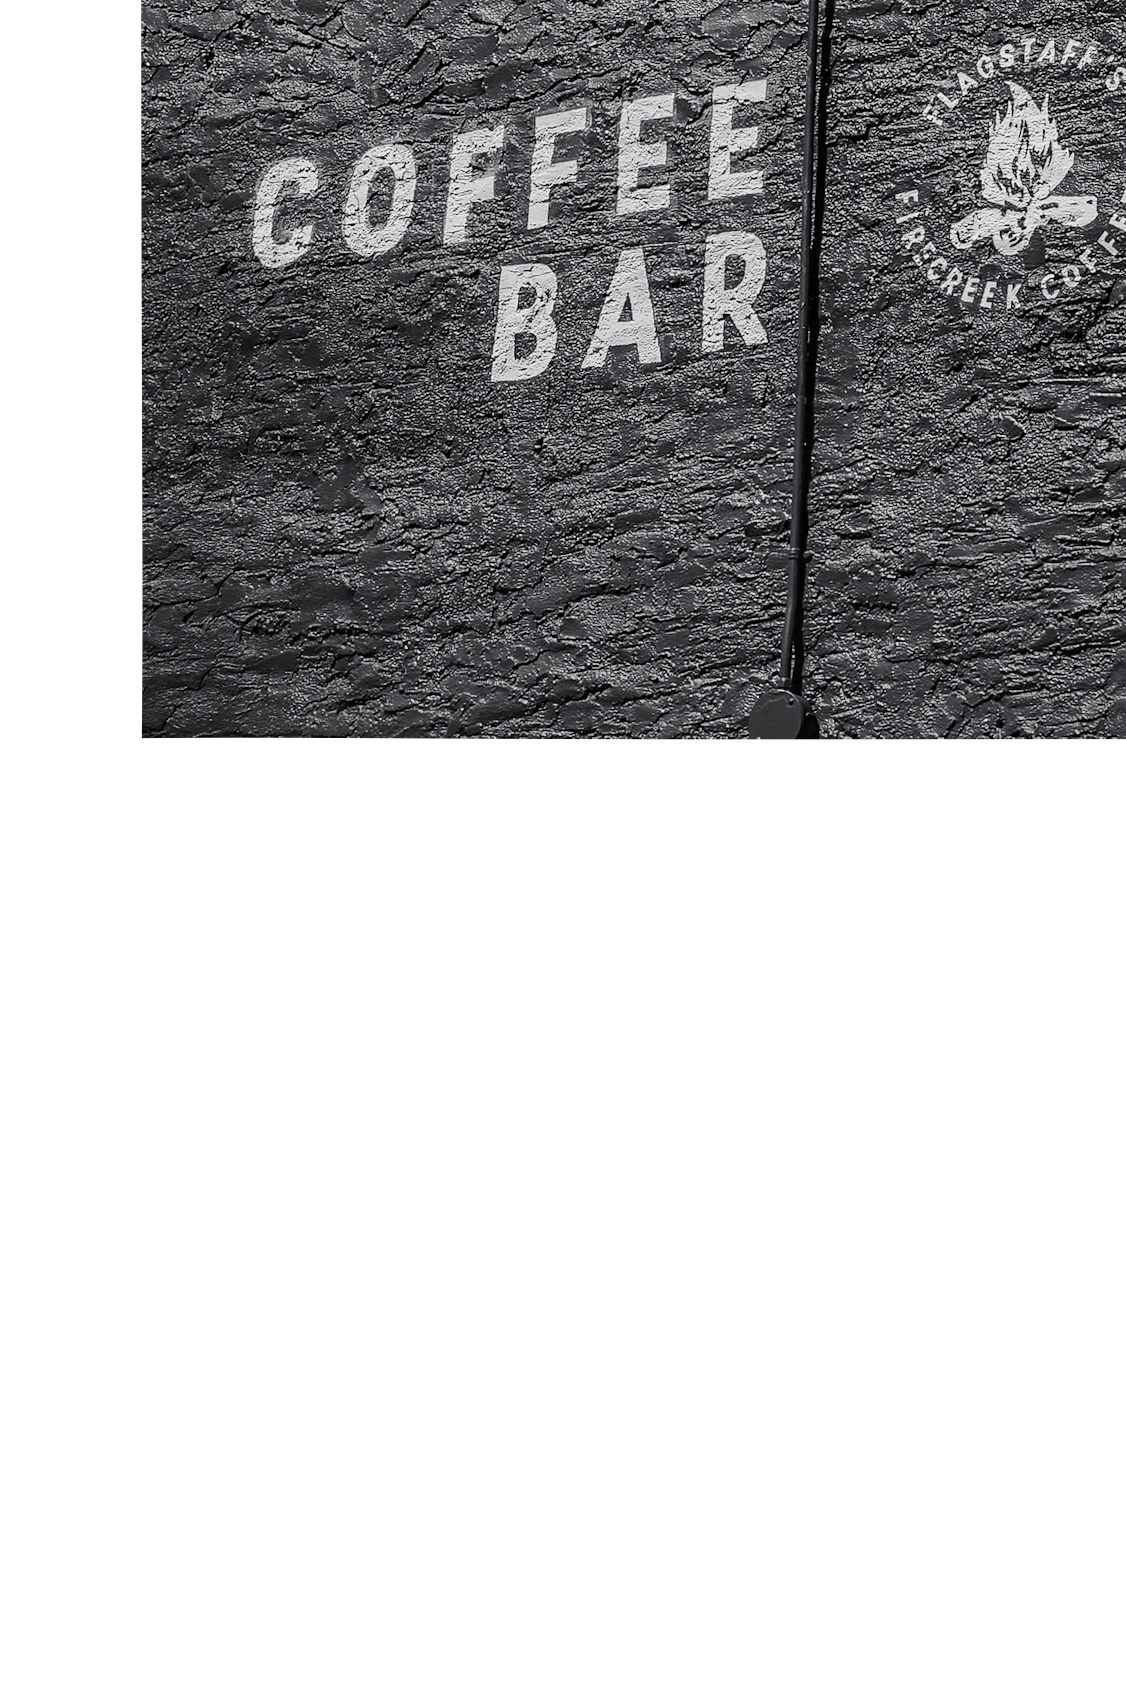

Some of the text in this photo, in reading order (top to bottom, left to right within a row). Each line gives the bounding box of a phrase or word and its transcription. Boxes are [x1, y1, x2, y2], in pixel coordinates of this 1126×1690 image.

[251, 79, 768, 269] COFFEE
[894, 188, 1022, 311] FIRECREEK
[490, 230, 769, 382] BAR
